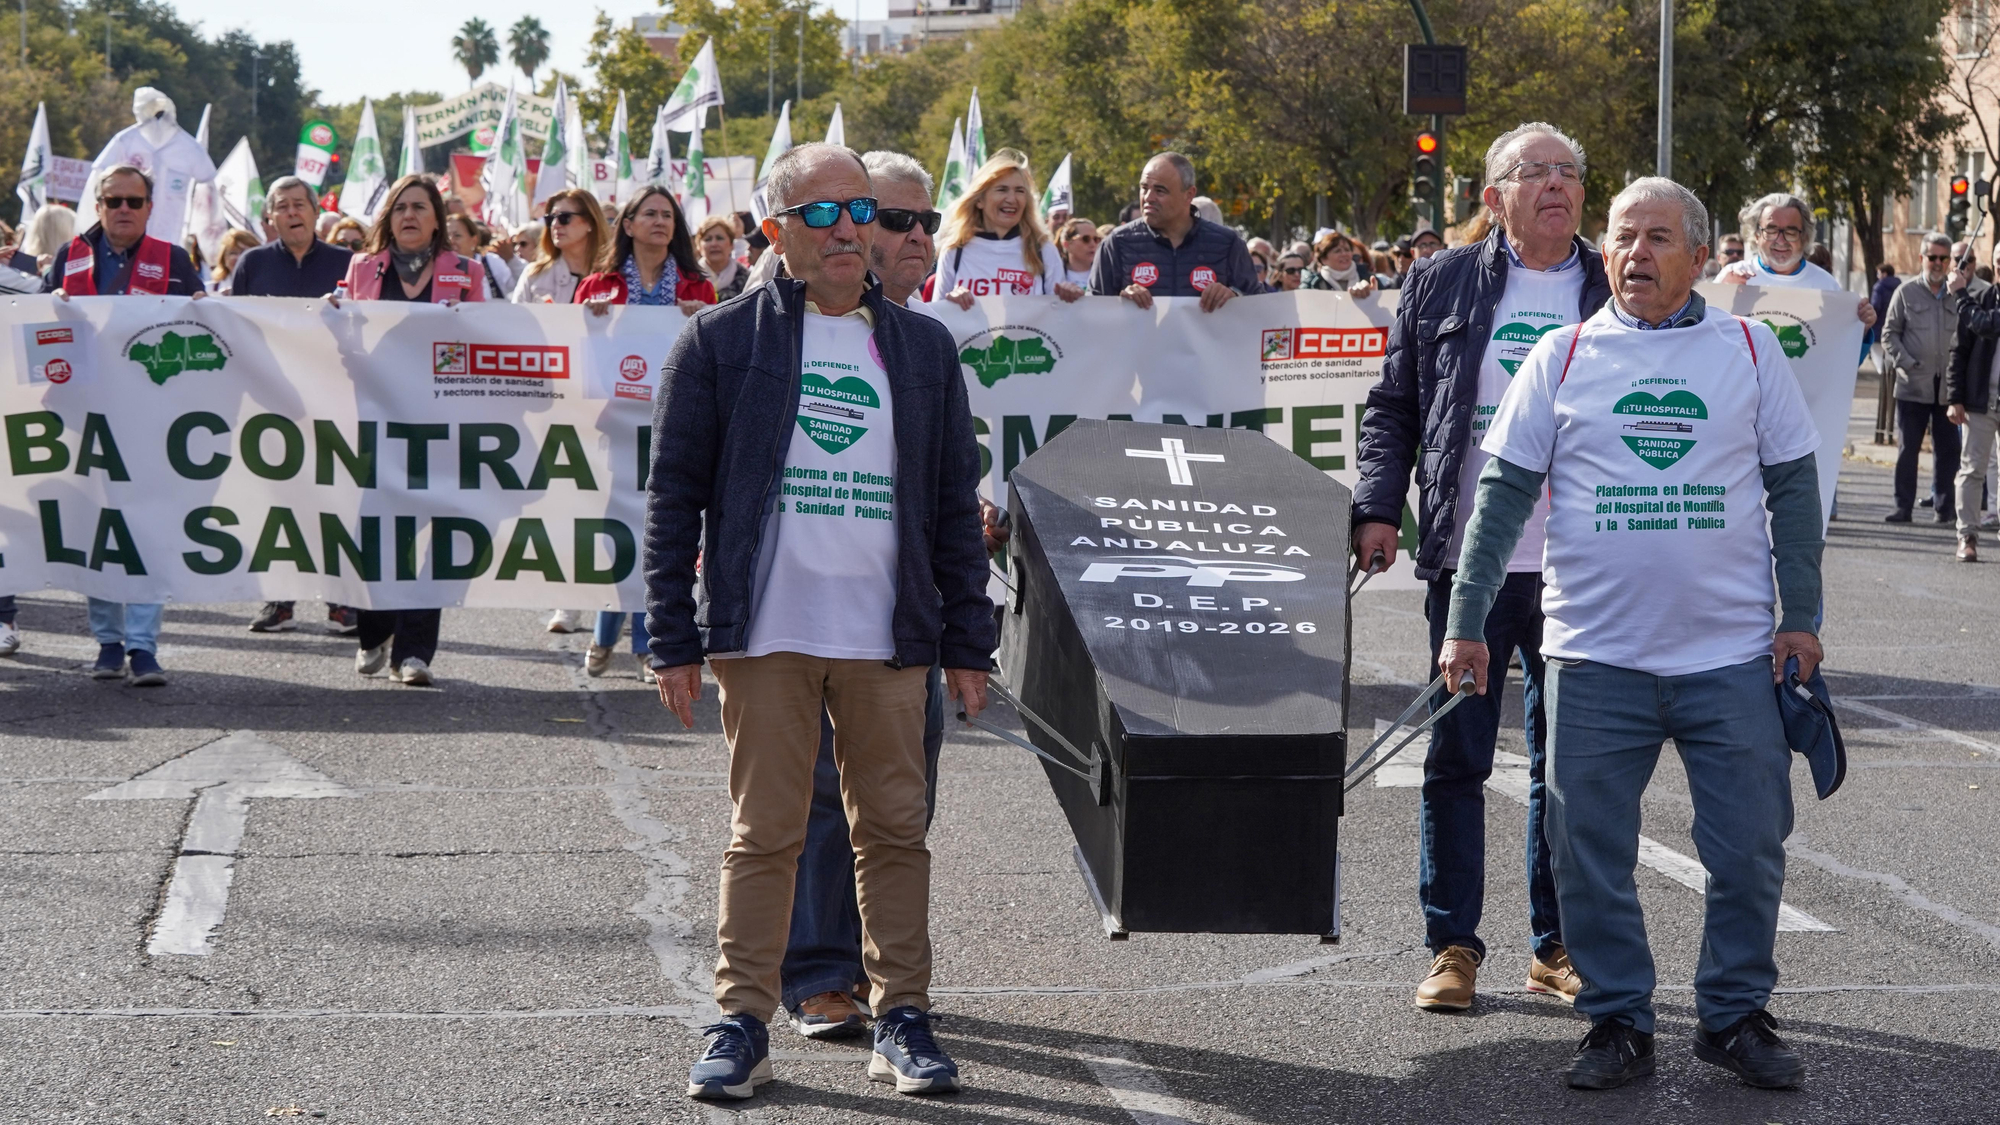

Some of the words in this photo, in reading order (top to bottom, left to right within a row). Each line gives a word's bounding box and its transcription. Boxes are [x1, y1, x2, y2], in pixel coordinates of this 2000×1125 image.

[532, 104, 552, 117] PO
[998, 271, 1023, 282] UGT
[1135, 266, 1156, 277] UGT
[1193, 270, 1214, 282] UGT
[1518, 311, 1557, 319] DEFIENDE
[1299, 333, 1383, 353] CCOO
[476, 350, 564, 372] CCOO
[622, 359, 644, 371] UGT
[811, 360, 853, 371] DEFIENDE
[1261, 360, 1308, 371] federación
[1311, 359, 1322, 368] de
[1325, 359, 1362, 368] sanidad
[434, 376, 487, 385] federación
[489, 376, 502, 385] de
[505, 377, 544, 387] sanidad
[1268, 373, 1307, 382] sectores
[1309, 370, 1380, 380] sociosanitarios
[434, 389, 440, 399] y
[443, 388, 486, 397] sectores
[488, 388, 565, 400] sociosanitarios
[802, 384, 815, 393] TU
[1473, 405, 1499, 416] Plata
[1644, 405, 1698, 416] HOSPITAL!!
[809, 420, 852, 435] SANIDAD
[1637, 439, 1681, 449] SANIDAD
[4, 410, 132, 482] BA
[166, 411, 599, 491] CONTRA
[832, 471, 848, 482] en
[783, 482, 832, 498] Hospital
[834, 487, 849, 500] de
[852, 488, 894, 504] Montilla
[1596, 485, 1658, 498] Plataforma
[1663, 485, 1678, 496] en
[1683, 483, 1726, 496] Defensa
[795, 501, 845, 517] Sanidad
[855, 505, 893, 521] Pública
[1094, 497, 1277, 517] SANIDAD
[1596, 501, 1612, 514] del
[1614, 501, 1664, 515] Hospital
[1666, 501, 1681, 513] de
[1684, 500, 1725, 512] Montilla
[1595, 520, 1601, 532] y
[1607, 518, 1618, 531] la
[1627, 518, 1678, 531] Sanidad
[1688, 516, 1725, 530] Pública
[38, 499, 148, 576] LA
[182, 505, 637, 585] SANIDAD
[1070, 536, 1312, 557] ANDALUZA
[1079, 560, 1306, 588] PP
[1103, 616, 1317, 634] 2019-2026
